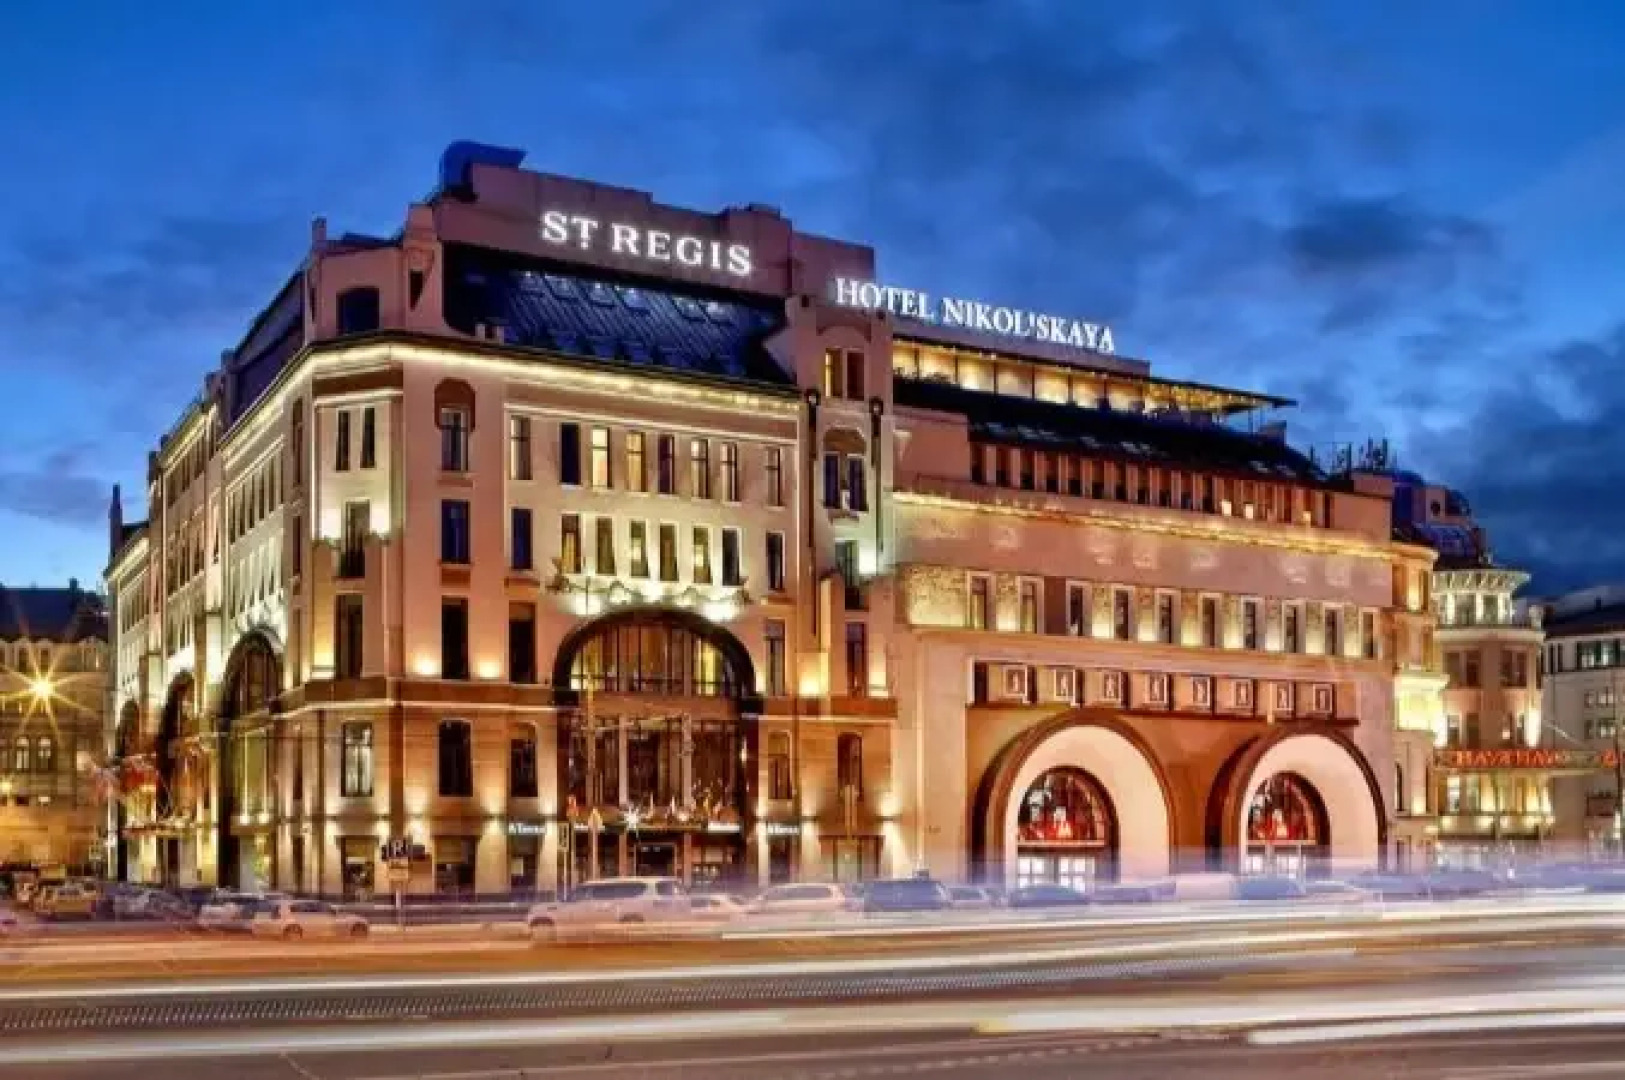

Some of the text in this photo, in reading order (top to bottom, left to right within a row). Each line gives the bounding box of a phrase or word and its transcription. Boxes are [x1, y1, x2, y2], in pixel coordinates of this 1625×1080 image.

[611, 222, 752, 276] REGIS
[836, 276, 1115, 354] HOTEL NIKOL'SKAYA
